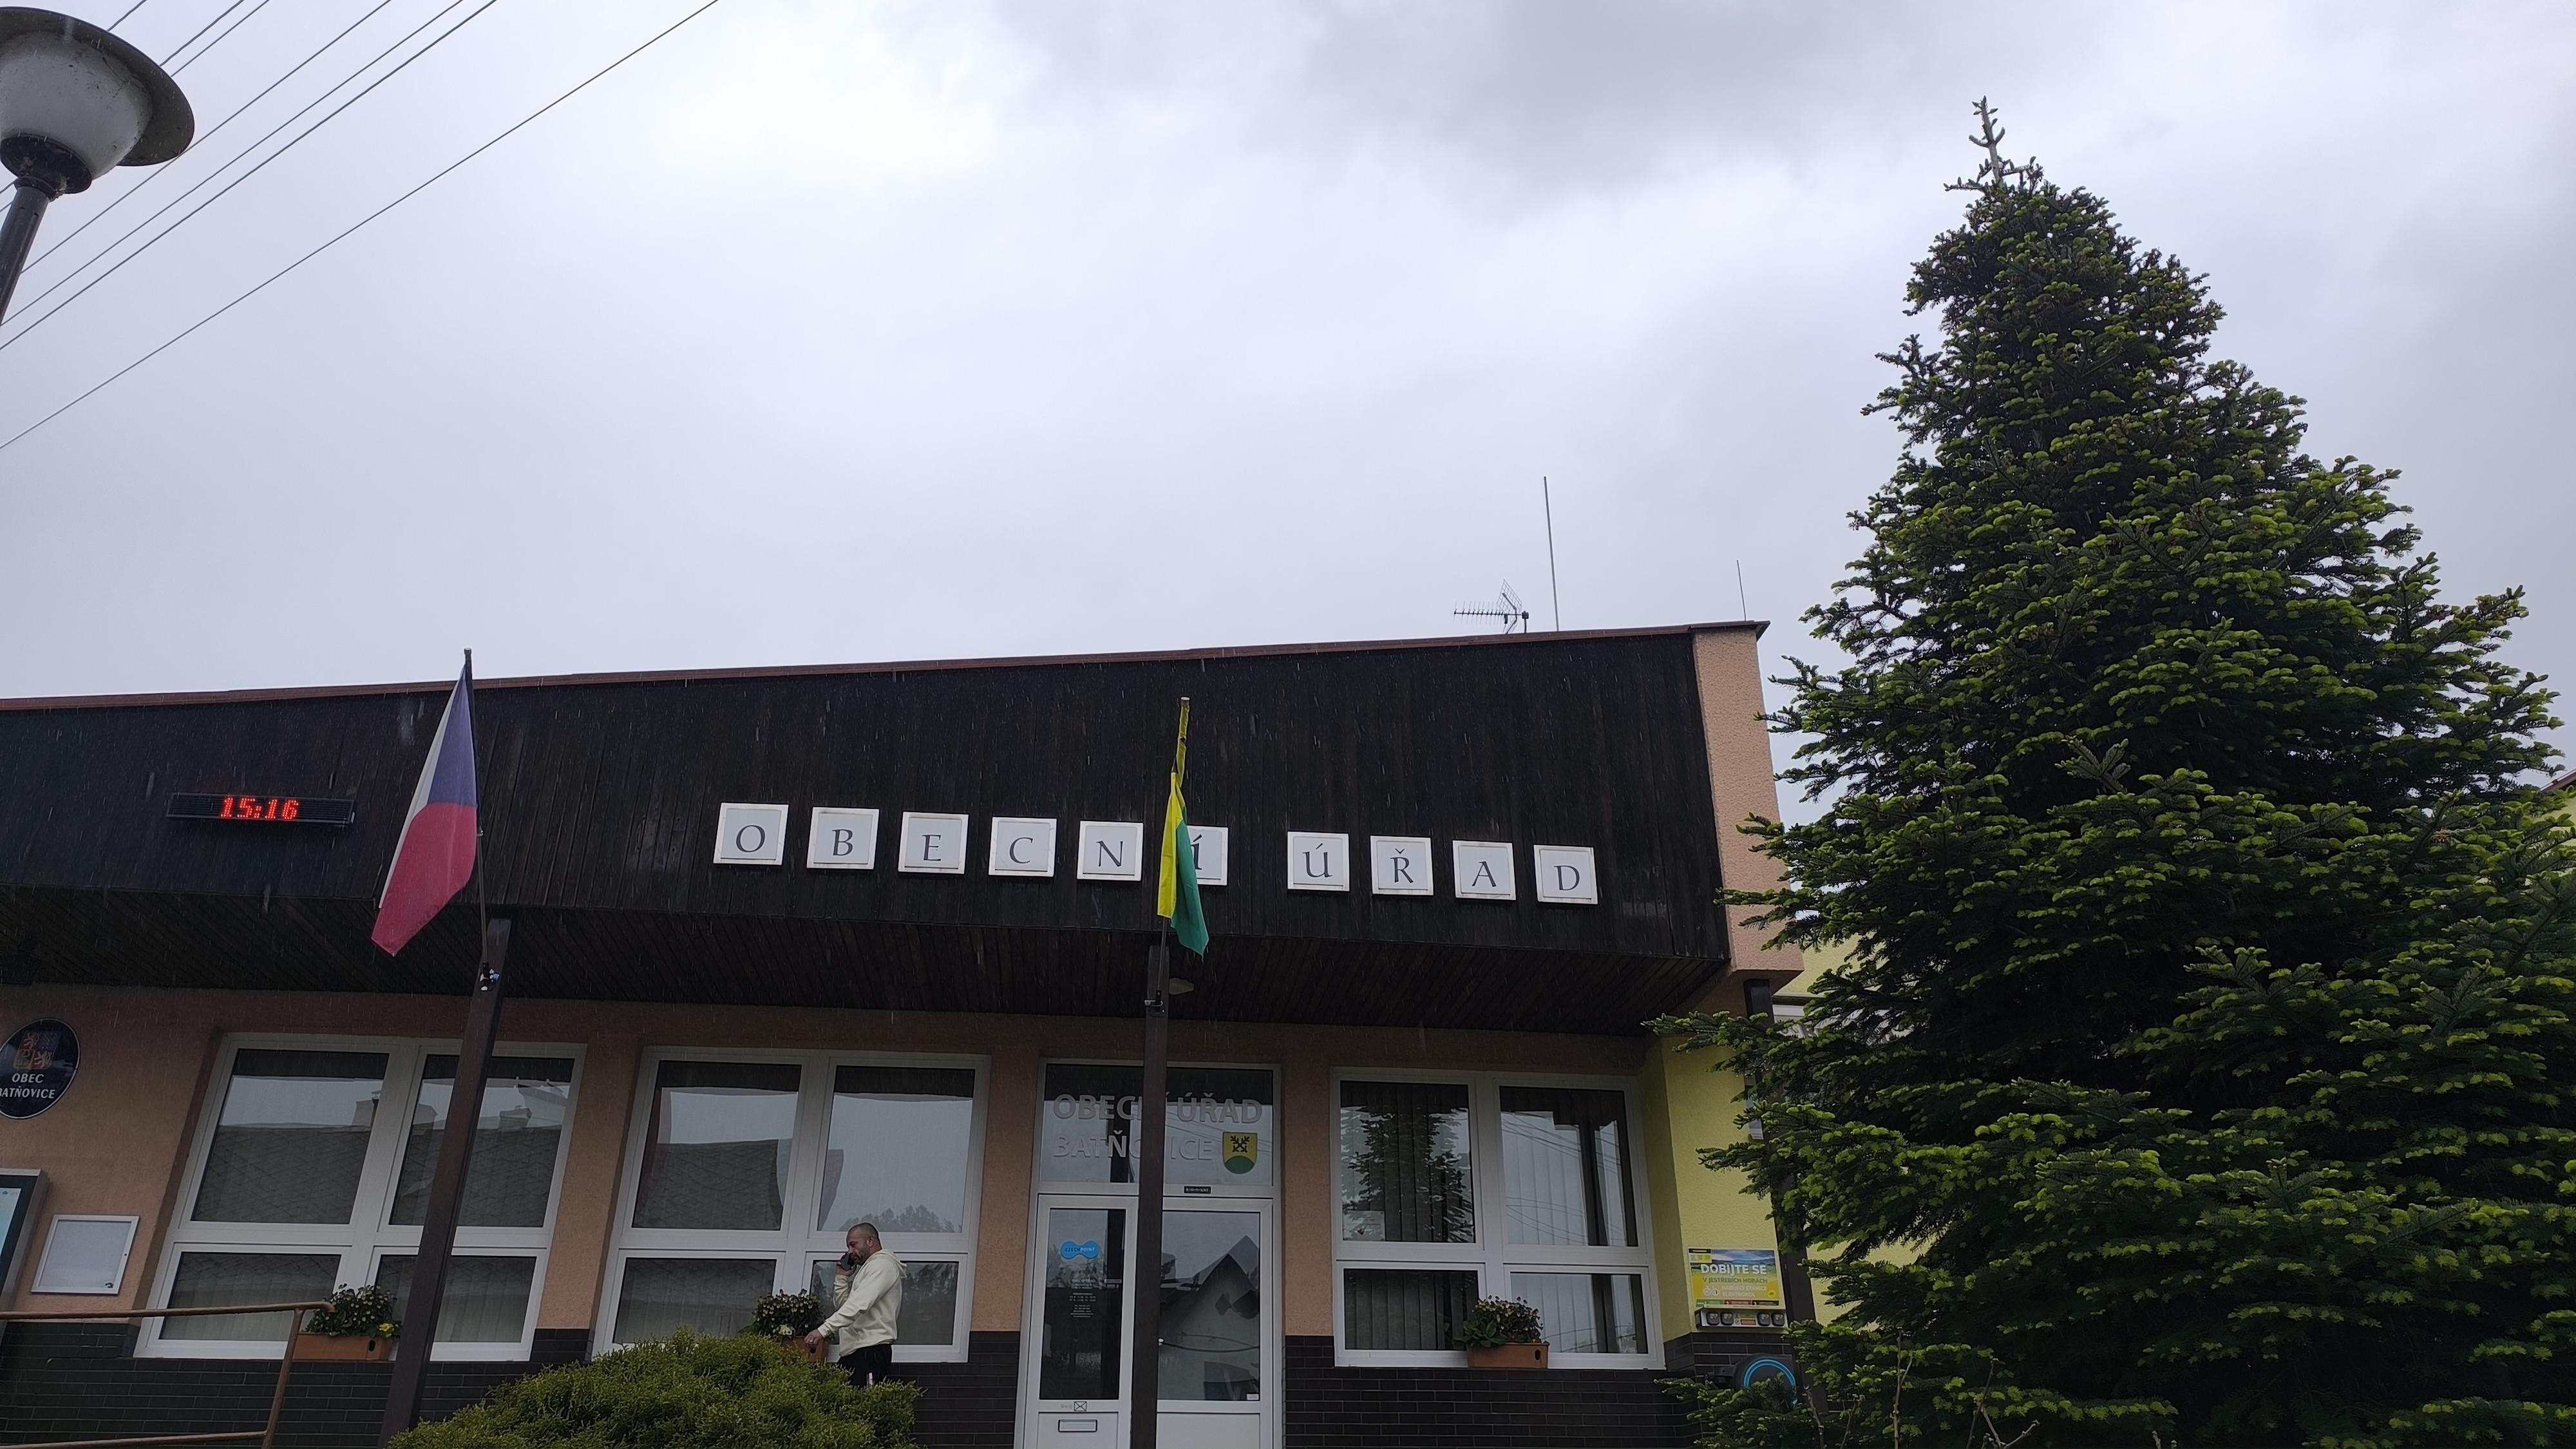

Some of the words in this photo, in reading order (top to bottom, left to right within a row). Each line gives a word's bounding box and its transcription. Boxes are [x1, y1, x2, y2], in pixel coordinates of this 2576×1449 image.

[220, 797, 299, 819] 15:16
[735, 824, 1202, 870] OBECNÍ
[1302, 843, 1581, 891] ÚŘAD
[12, 1073, 44, 1083] OBEC
[1053, 1093, 1170, 1121] OBEC
[1177, 1092, 1263, 1124] ÚŘAD
[1700, 1264, 1750, 1276] DOBIJTE
[1752, 1265, 1767, 1274] SE
